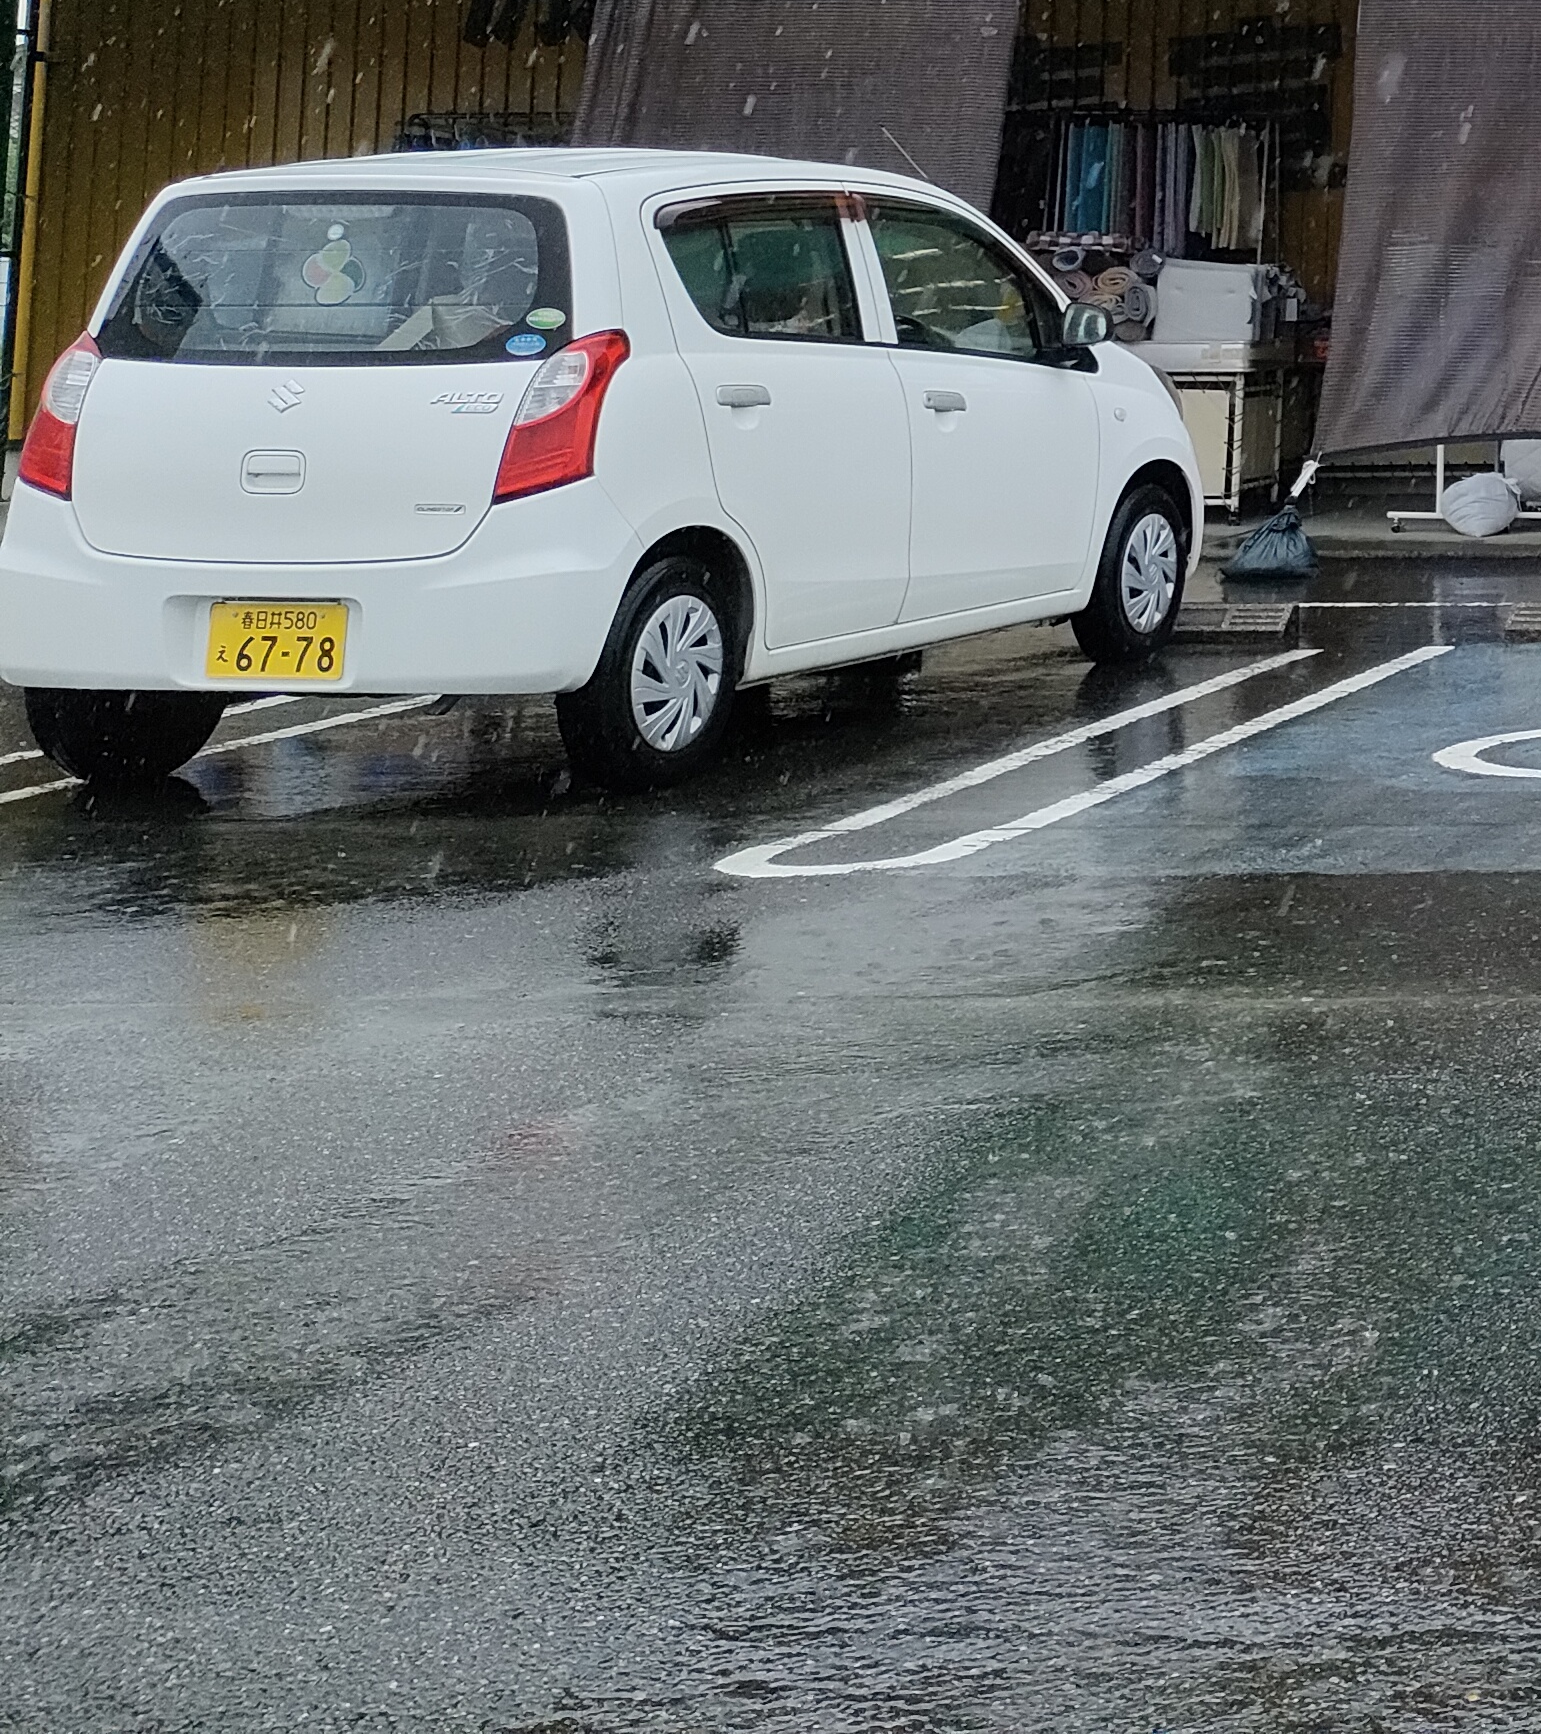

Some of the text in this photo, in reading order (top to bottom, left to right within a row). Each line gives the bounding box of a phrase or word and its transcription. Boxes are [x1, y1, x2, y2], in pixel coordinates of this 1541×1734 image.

[430, 392, 505, 405] ALTO
[465, 404, 492, 412] ECO
[241, 610, 318, 630] 春日井580
[215, 635, 335, 673] え 67-78
